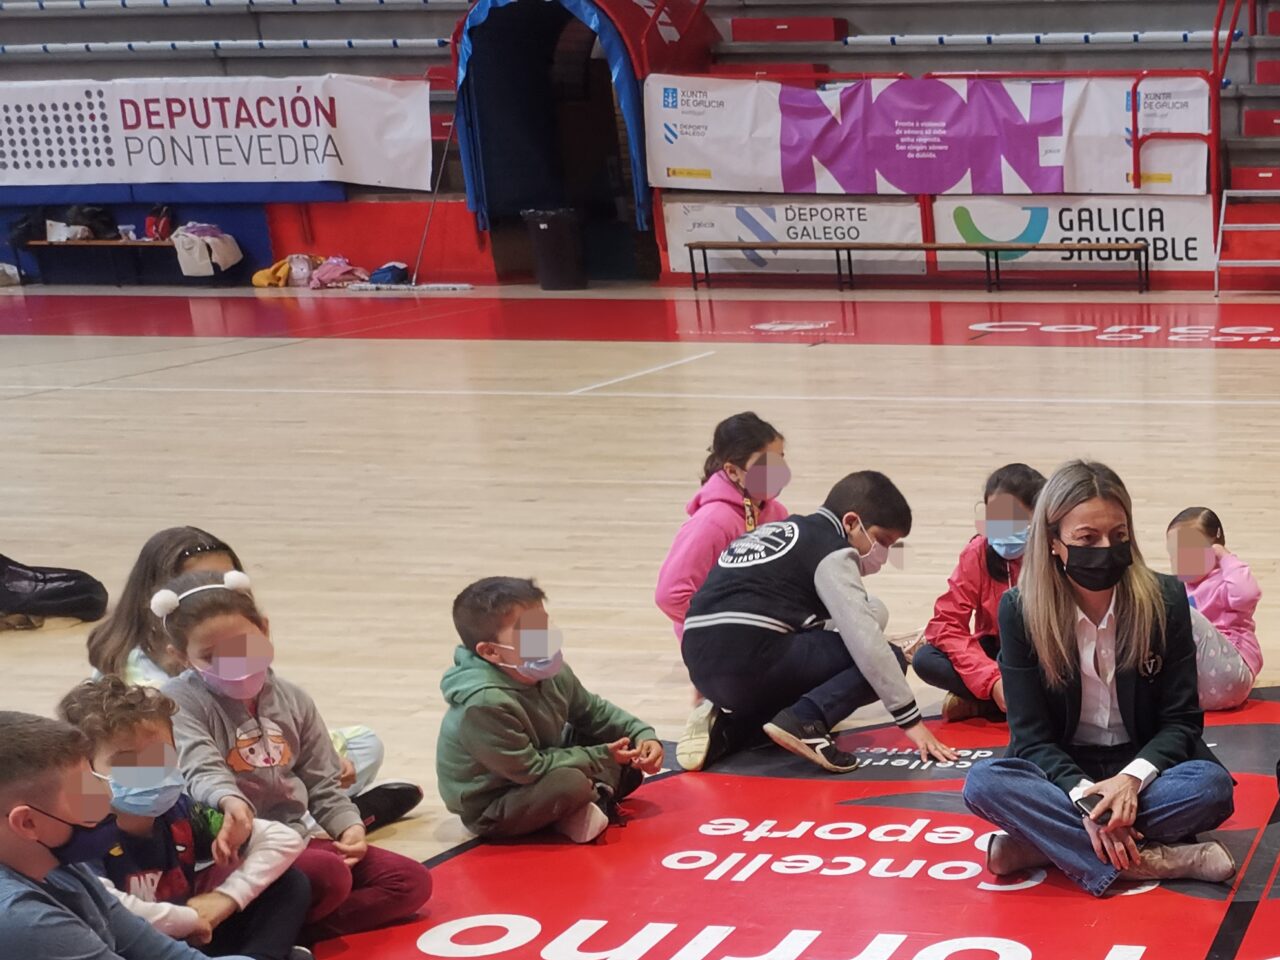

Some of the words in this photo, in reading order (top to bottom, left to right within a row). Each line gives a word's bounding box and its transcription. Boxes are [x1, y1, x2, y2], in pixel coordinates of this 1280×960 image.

[681, 90, 708, 99] XUNTA
[119, 85, 337, 130] DEPUTACIÓN
[1144, 101, 1154, 109] DE
[1155, 102, 1189, 110] GALICIA
[124, 133, 344, 167] PONTEVEDRA
[785, 207, 867, 221] DEPORTE
[1058, 208, 1165, 232] GALICIA
[786, 226, 860, 240] GALEGO
[1060, 237, 1198, 261] SAUDABLE
[1096, 333, 1144, 341] O
